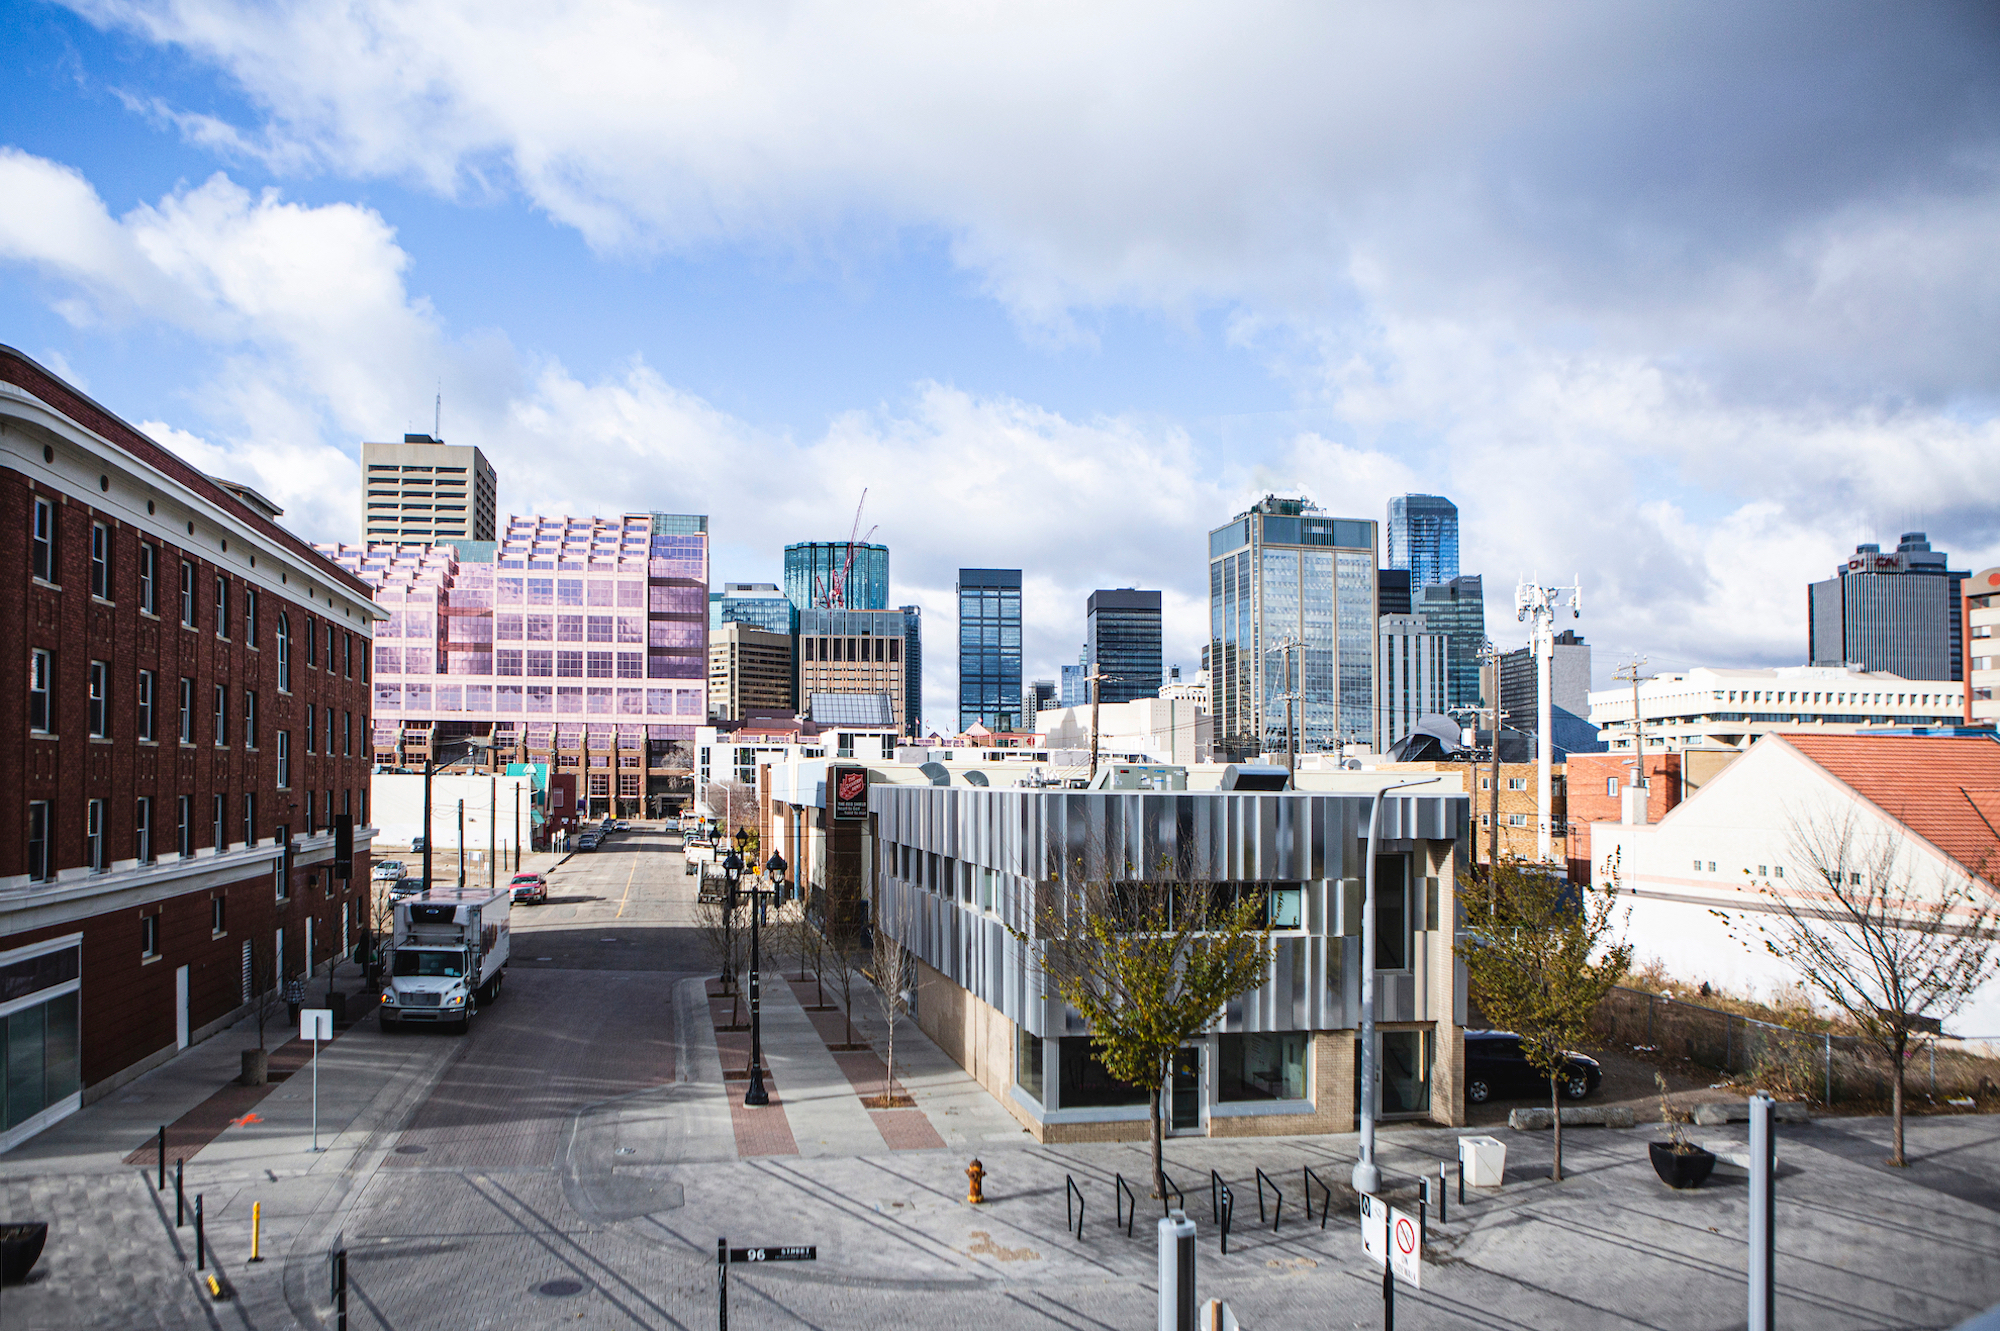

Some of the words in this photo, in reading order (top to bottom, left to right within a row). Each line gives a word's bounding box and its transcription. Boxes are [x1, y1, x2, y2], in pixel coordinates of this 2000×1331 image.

[1849, 558, 1864, 569] CN
[1876, 556, 1899, 566] CN
[747, 1248, 766, 1262] 96
[781, 1247, 810, 1255] STREET
